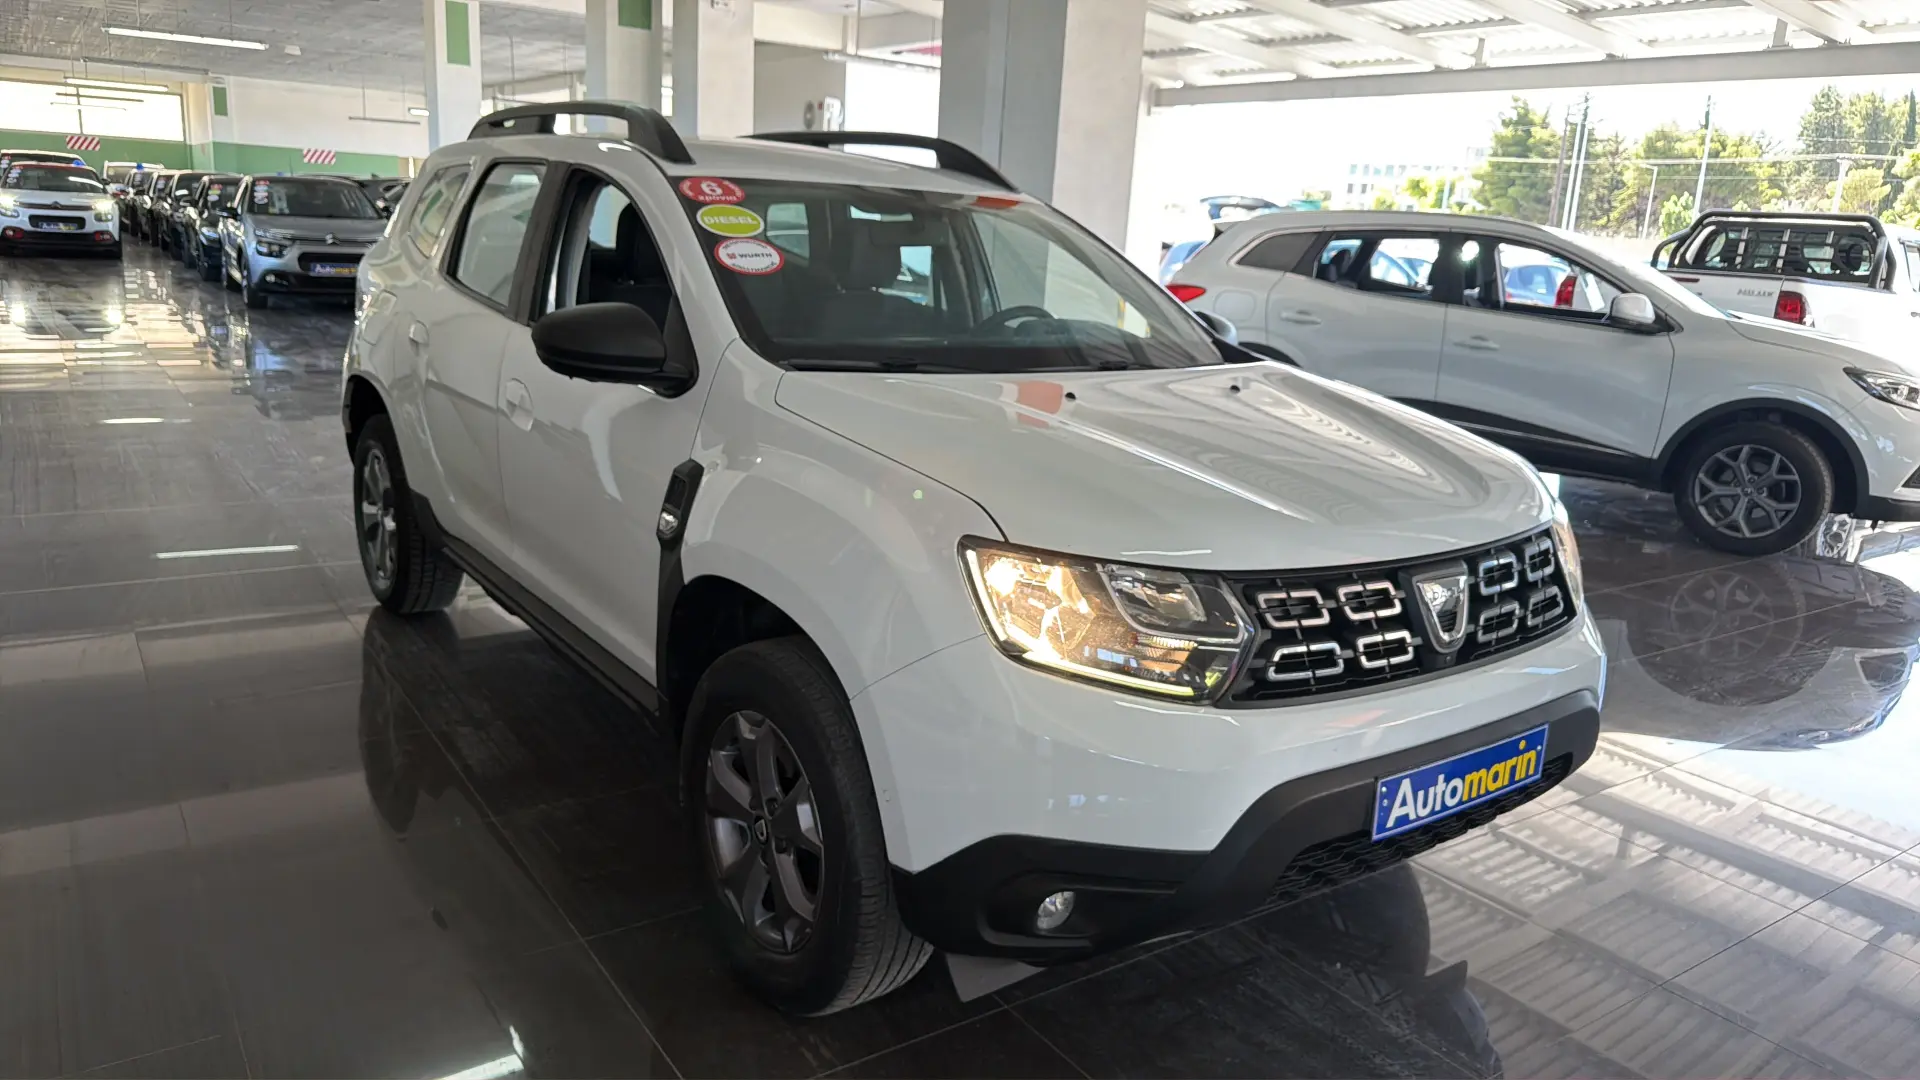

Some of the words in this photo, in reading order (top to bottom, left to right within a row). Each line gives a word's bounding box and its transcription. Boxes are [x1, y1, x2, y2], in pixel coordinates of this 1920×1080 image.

[701, 181, 723, 196] 6
[703, 215, 758, 225] DIESEL
[1386, 739, 1536, 828] Automarin
